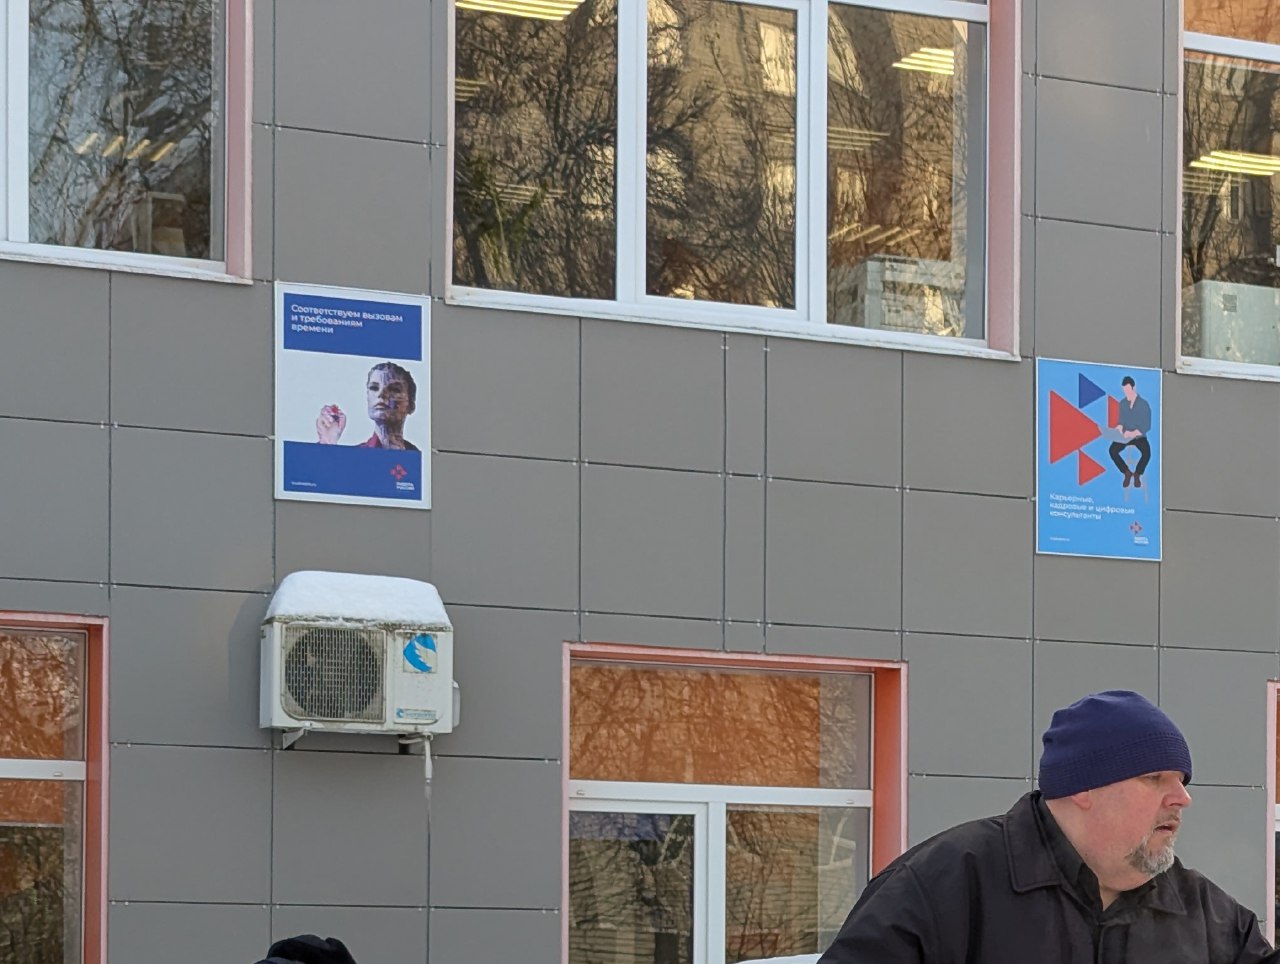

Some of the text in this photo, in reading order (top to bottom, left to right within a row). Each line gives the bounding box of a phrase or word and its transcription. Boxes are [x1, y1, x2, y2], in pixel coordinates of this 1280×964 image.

[291, 304, 403, 322] Соответствуем вызовам
[300, 315, 363, 328] требованиям
[291, 324, 334, 334] времени
[1050, 502, 1087, 512] кадровые
[1096, 505, 1135, 515] цифровые
[1050, 511, 1102, 520] консультанты
